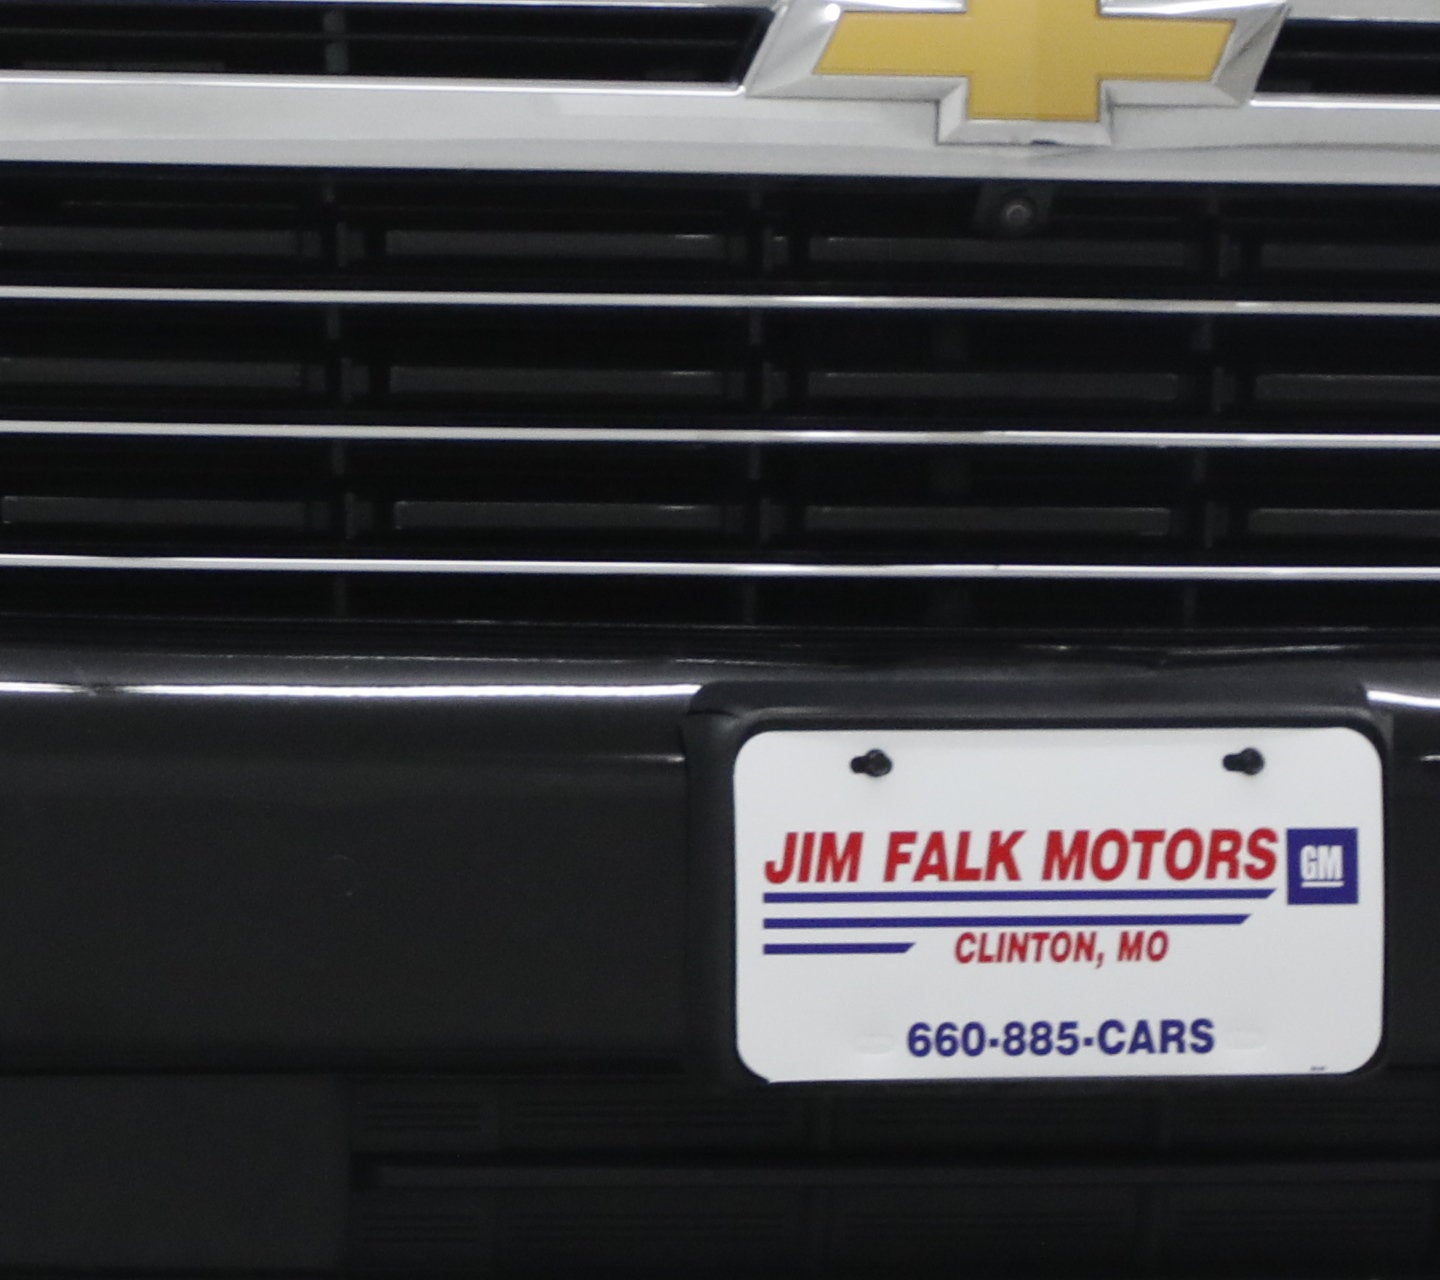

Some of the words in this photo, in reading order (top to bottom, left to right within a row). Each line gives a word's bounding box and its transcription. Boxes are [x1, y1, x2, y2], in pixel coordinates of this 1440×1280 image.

[764, 832, 863, 884] JIM
[884, 830, 1024, 882] FALK
[1042, 828, 1278, 881] MOTORS
[1300, 845, 1343, 881] GM
[955, 931, 1104, 968] CLINTON,
[1118, 930, 1169, 962] MO
[906, 1018, 1215, 1057] 660-885-CARS
